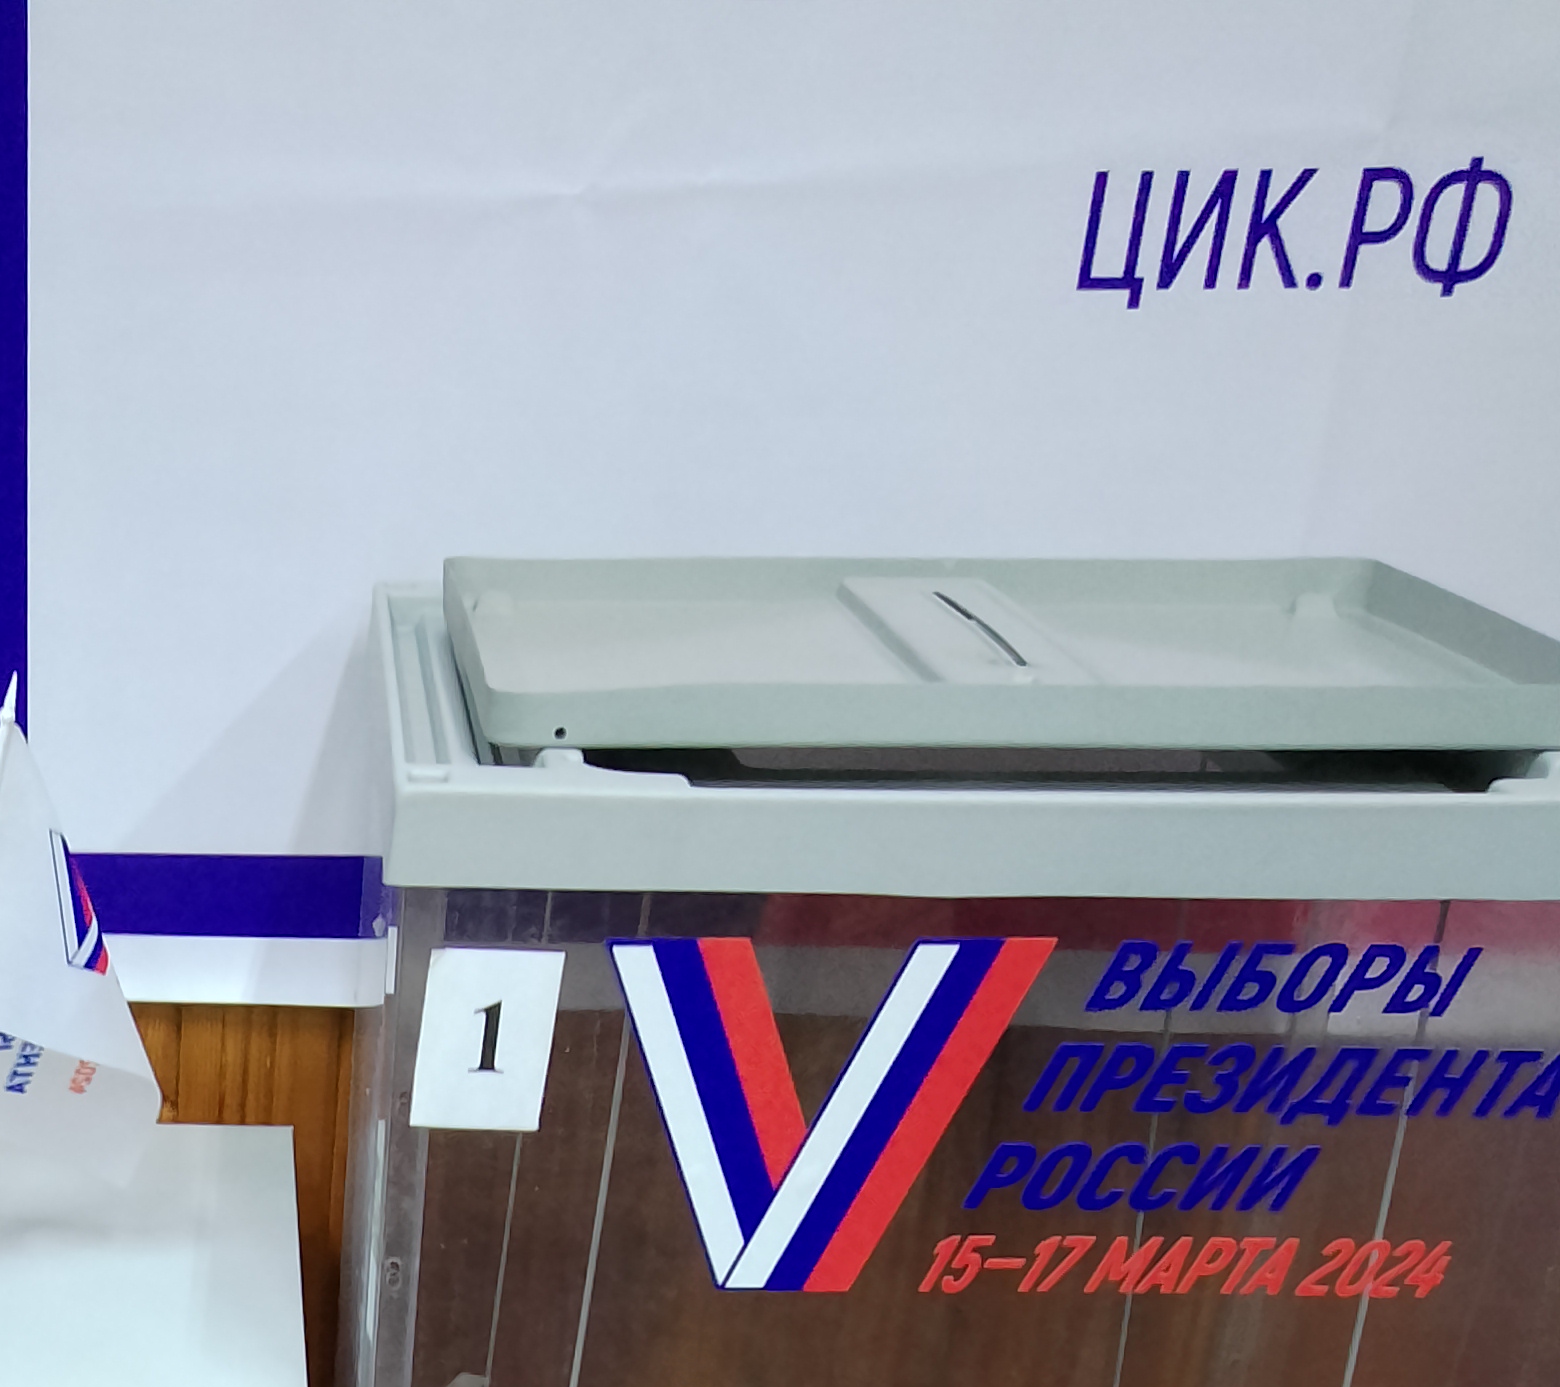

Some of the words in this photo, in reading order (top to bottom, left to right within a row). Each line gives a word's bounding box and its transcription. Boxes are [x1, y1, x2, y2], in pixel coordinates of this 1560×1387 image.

[1075, 156, 1514, 309] ЦИК.РФ
[1084, 939, 1484, 1017] ВЫБОРЫ
[468, 999, 505, 1074] 1
[1022, 1042, 1560, 1125] ПРЕЗИДЕНТА
[962, 1141, 1322, 1213] РОССИИ
[1084, 1235, 1301, 1297] МАРТА
[1295, 1237, 1453, 1299] 2024
